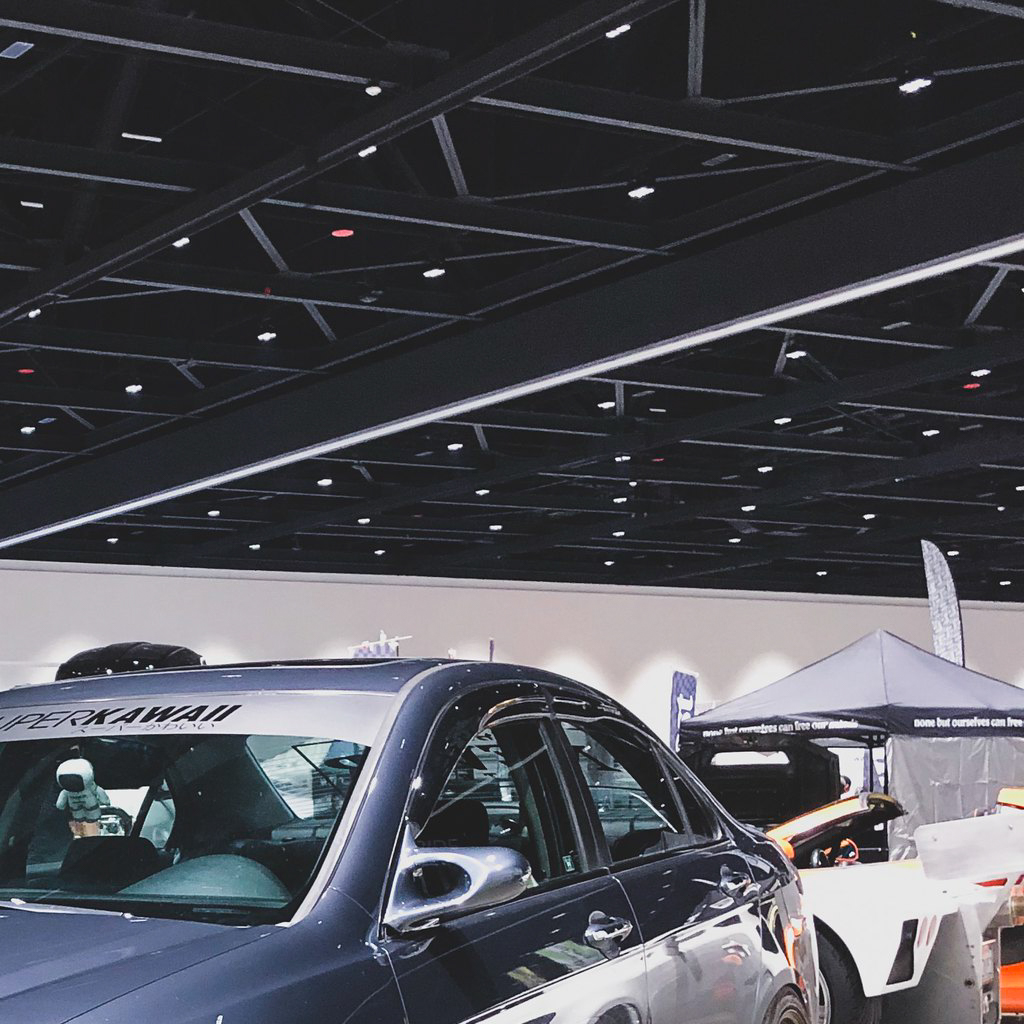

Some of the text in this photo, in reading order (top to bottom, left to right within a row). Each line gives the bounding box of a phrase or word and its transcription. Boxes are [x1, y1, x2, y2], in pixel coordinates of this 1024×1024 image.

[794, 720, 811, 731] free
[914, 718, 935, 728] none
[936, 717, 951, 728] but
[1007, 716, 1023, 728] free
